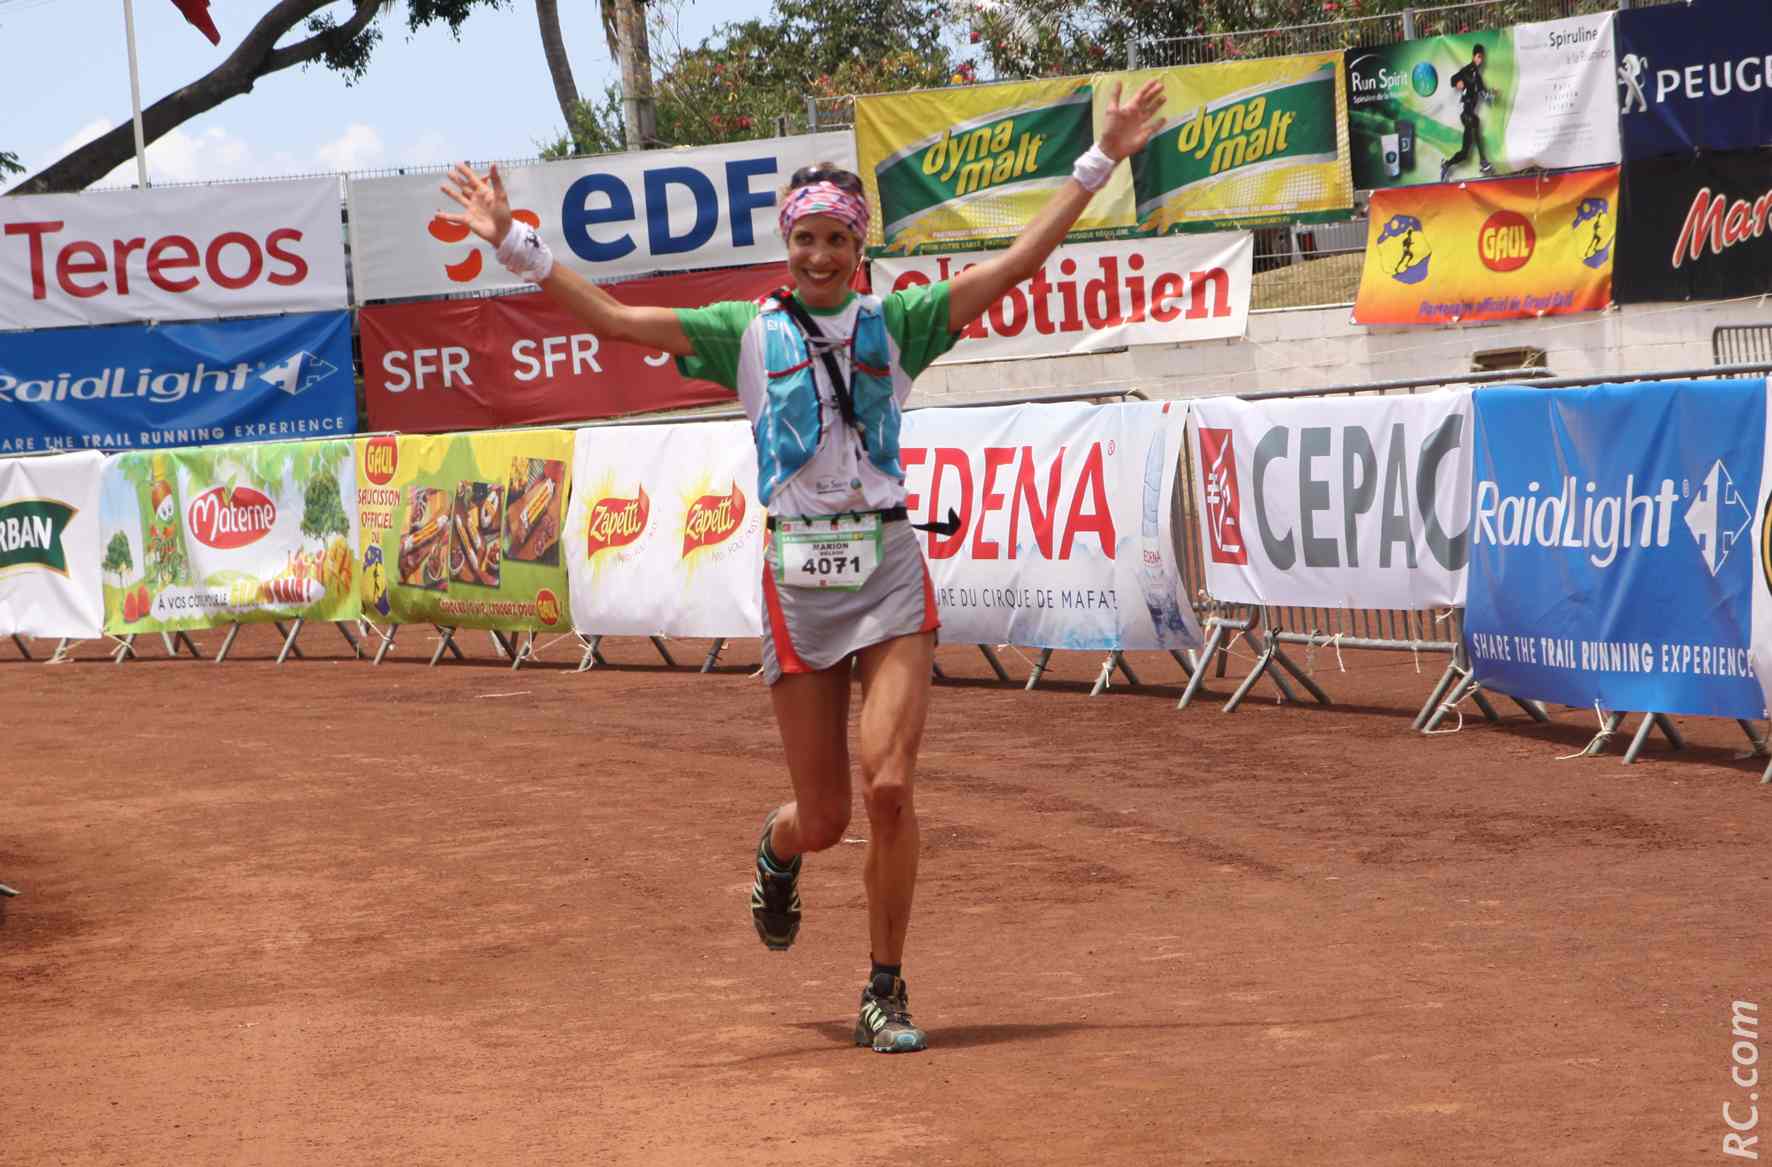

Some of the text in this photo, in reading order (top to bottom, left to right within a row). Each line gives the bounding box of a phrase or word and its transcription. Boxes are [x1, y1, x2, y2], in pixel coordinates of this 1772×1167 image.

[1549, 27, 1598, 49] Spiruline
[1352, 67, 1408, 92] Run Spirit
[922, 119, 1014, 183] dyna
[1178, 96, 1267, 160] dyna
[1210, 109, 1293, 174] malt
[955, 132, 1041, 196] malt
[4, 221, 309, 300] Tereos
[1483, 225, 1529, 261] GAUL
[892, 252, 1232, 340] otidien
[382, 333, 602, 392] SFR SFR
[2, 417, 345, 450] ARE THE TRAIL RUNNING EXPERIENCE
[367, 445, 394, 477] GAUL
[358, 488, 400, 504] SAUCISSON
[899, 441, 1117, 561] EDENA
[1253, 414, 1470, 571] CEPAC
[193, 494, 274, 541] Materne
[361, 511, 392, 528] OFFICIEL
[591, 501, 642, 544] Zapetti
[686, 498, 735, 544] Zapetti
[1474, 474, 1679, 567] RaidLight
[801, 556, 860, 575] 4071
[961, 588, 977, 607] DU
[983, 588, 1031, 608] CIRQUE
[1037, 589, 1053, 609] DE
[1472, 633, 1754, 678] SHARE THE TRAIL RUNNING EXPERIENCE
